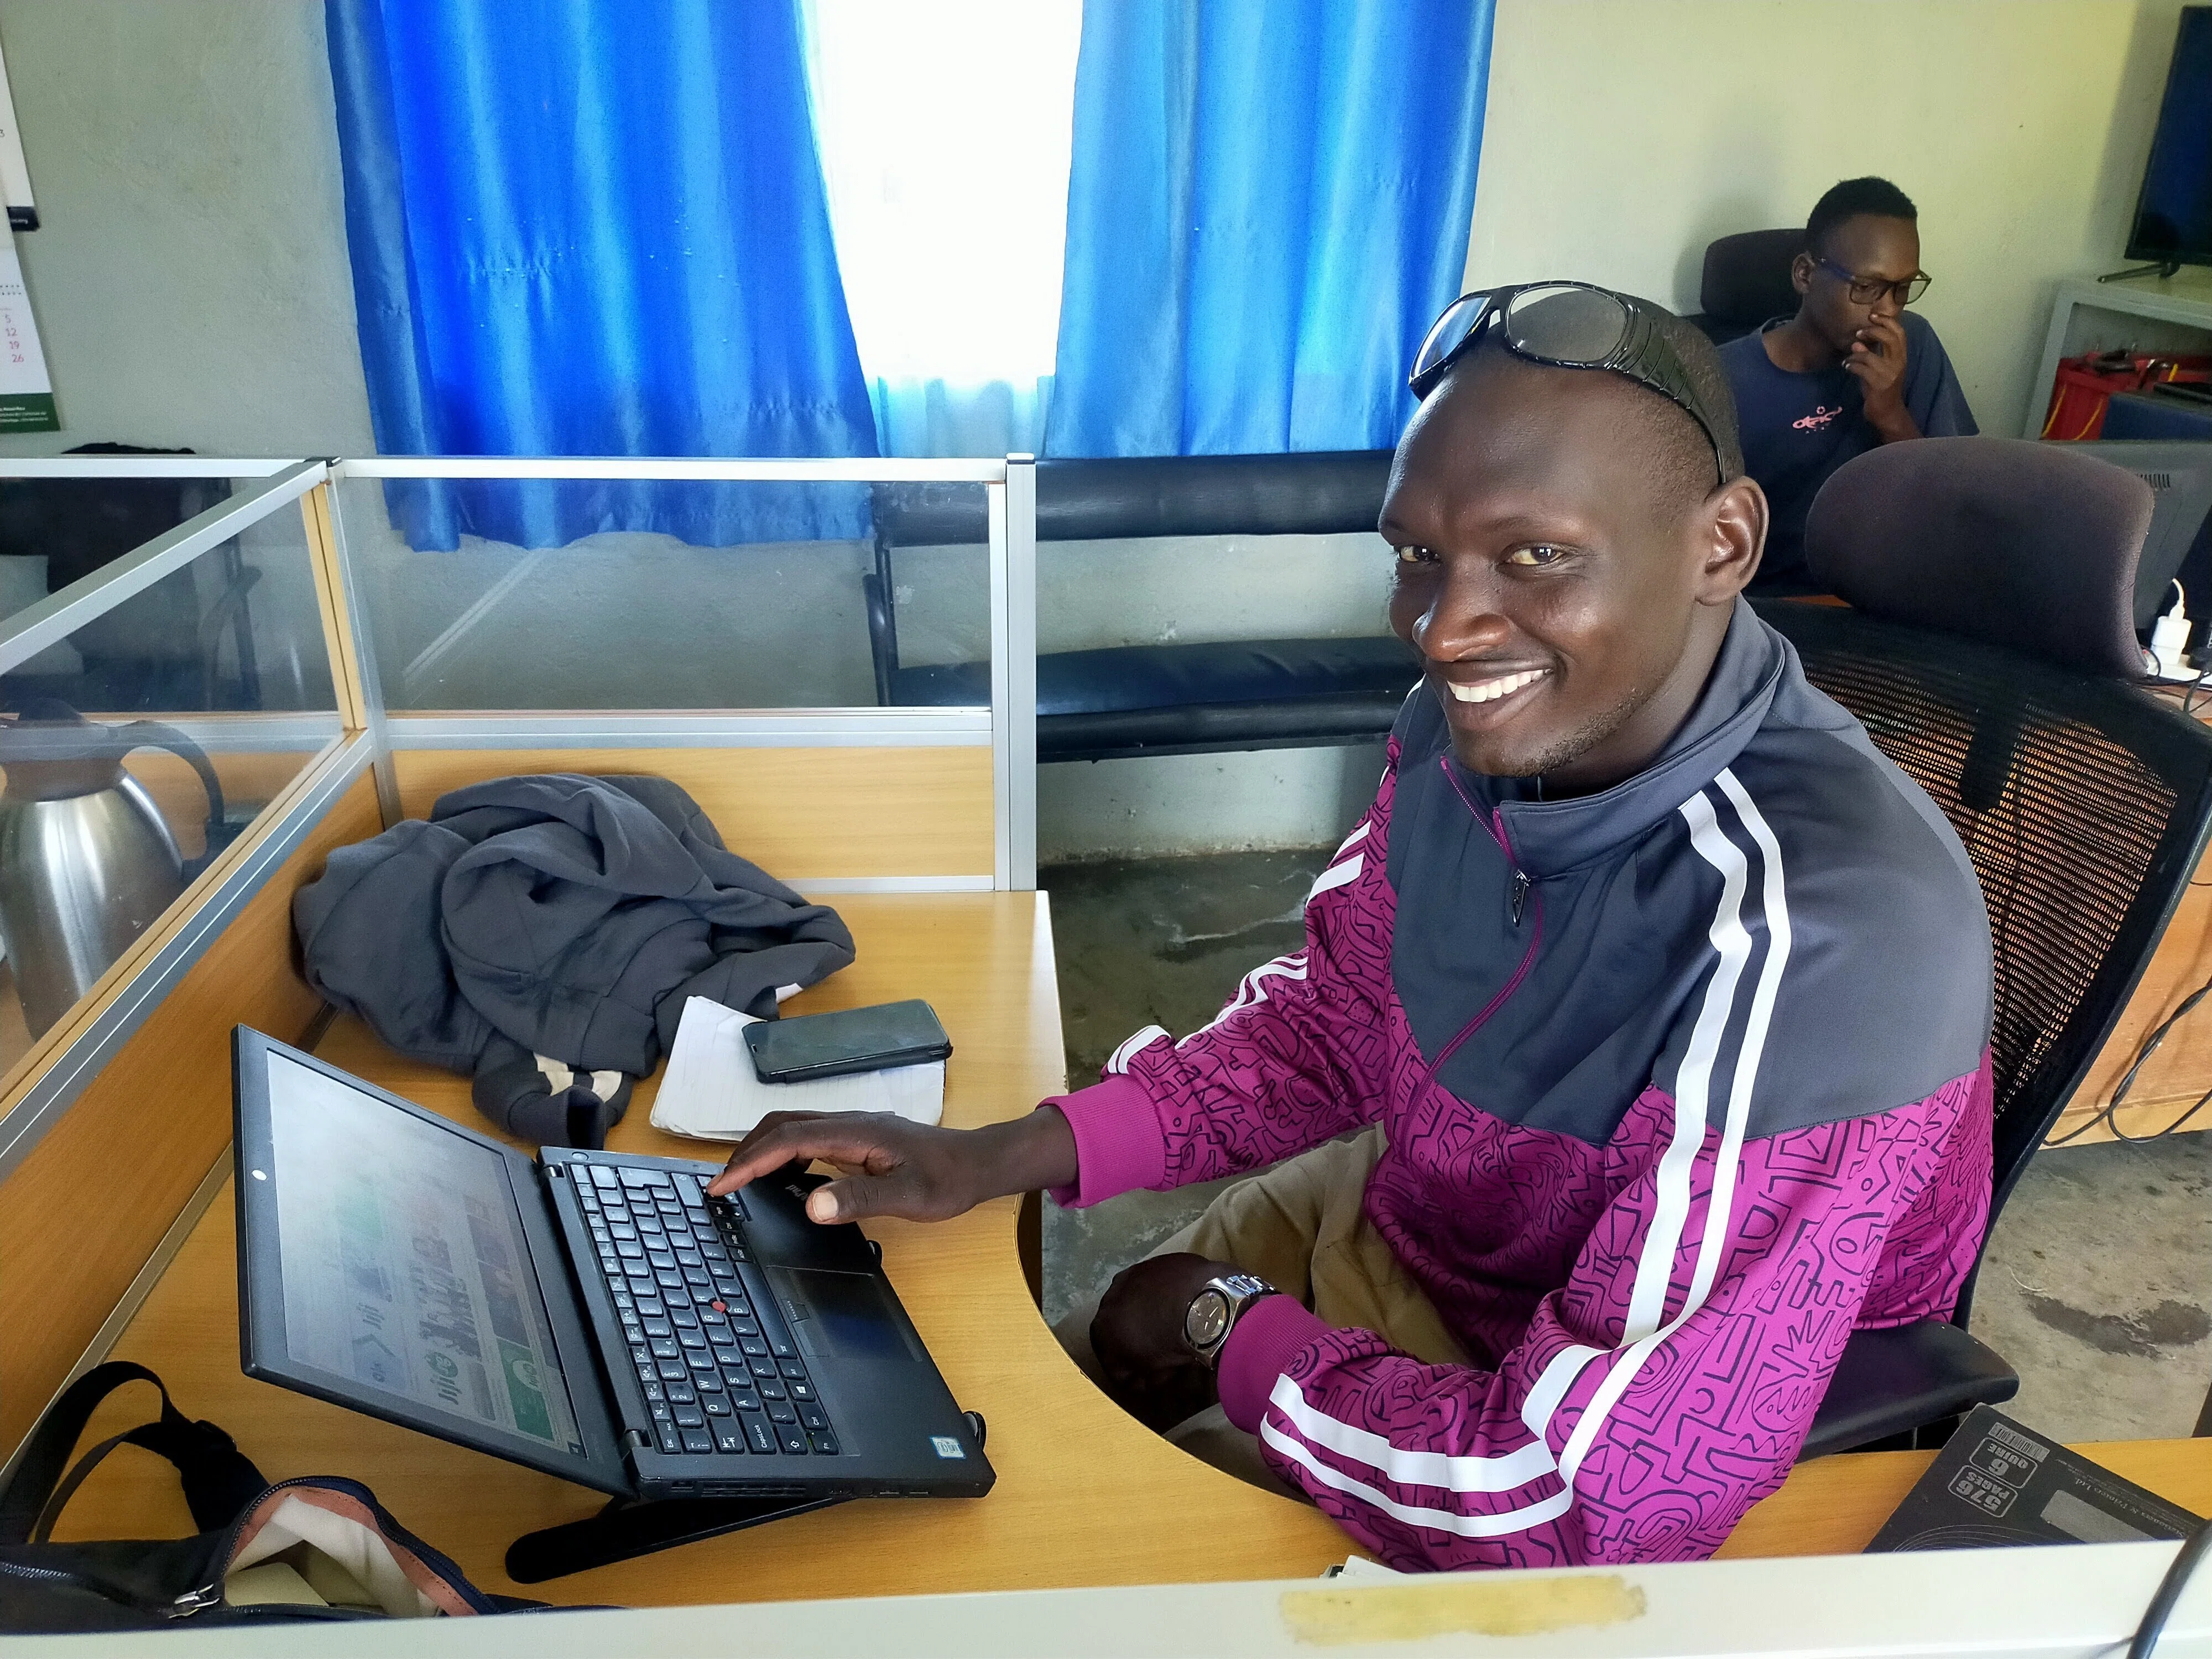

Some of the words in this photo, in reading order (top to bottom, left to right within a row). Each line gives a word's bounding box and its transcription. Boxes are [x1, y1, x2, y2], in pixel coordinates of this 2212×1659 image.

[6, 328, 17, 337] 12
[9, 341, 19, 349] 19
[12, 354, 24, 363] 26
[754, 1425, 768, 1448] CapsLock
[1987, 1443, 2028, 1469] QUIRE
[1988, 1458, 2009, 1476] 6
[1956, 1480, 2001, 1511] 576
[1966, 1472, 2010, 1499] PAGES
